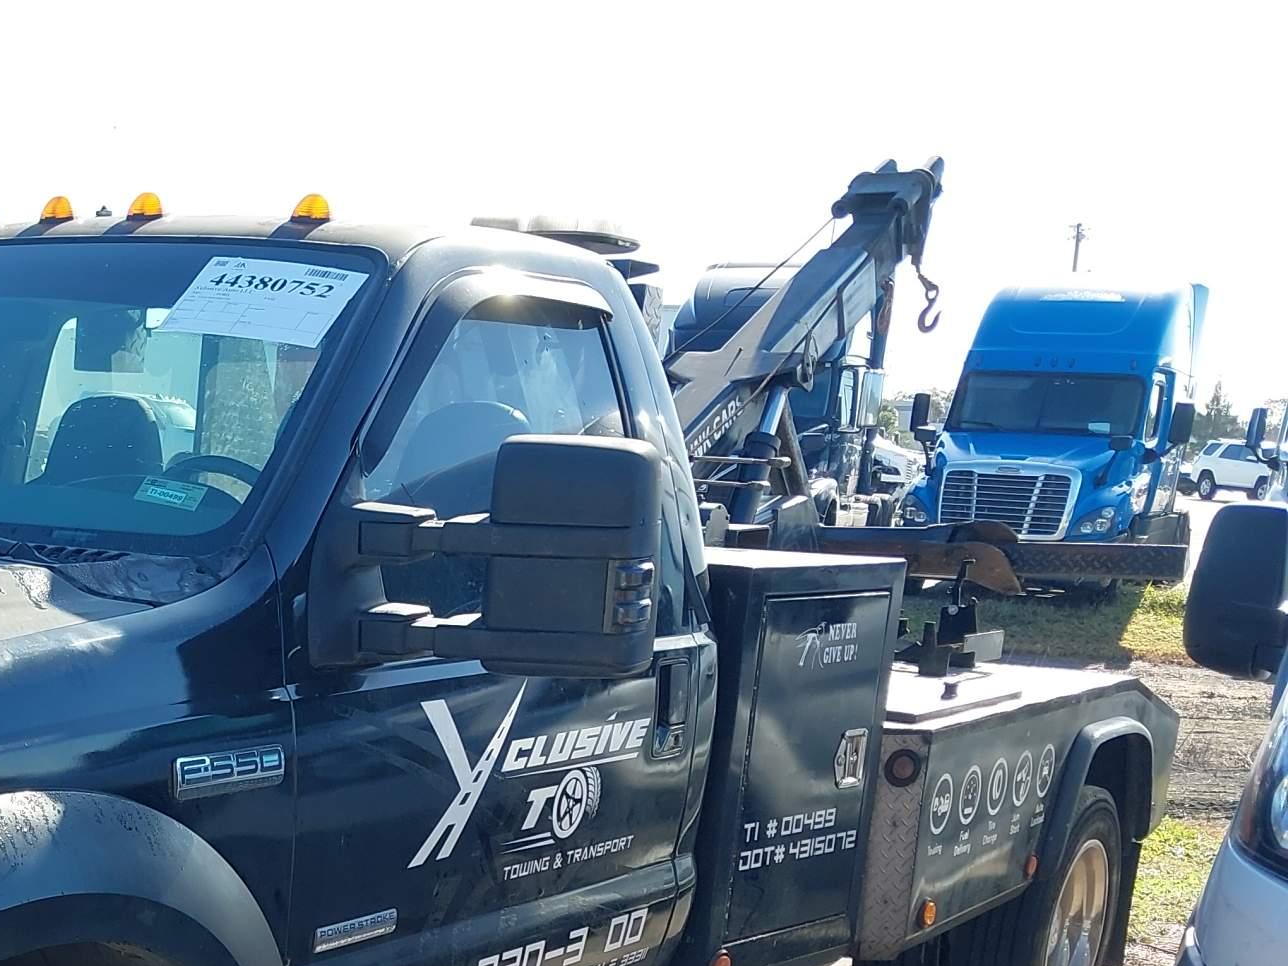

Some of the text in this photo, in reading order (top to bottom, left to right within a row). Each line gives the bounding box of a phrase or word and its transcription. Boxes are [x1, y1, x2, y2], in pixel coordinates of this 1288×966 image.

[210, 273, 334, 298] 44380752
[828, 622, 857, 641] NEVER
[823, 643, 858, 664] GIVE UP!
[503, 835, 634, 880] TOWING & TRANSPORT
